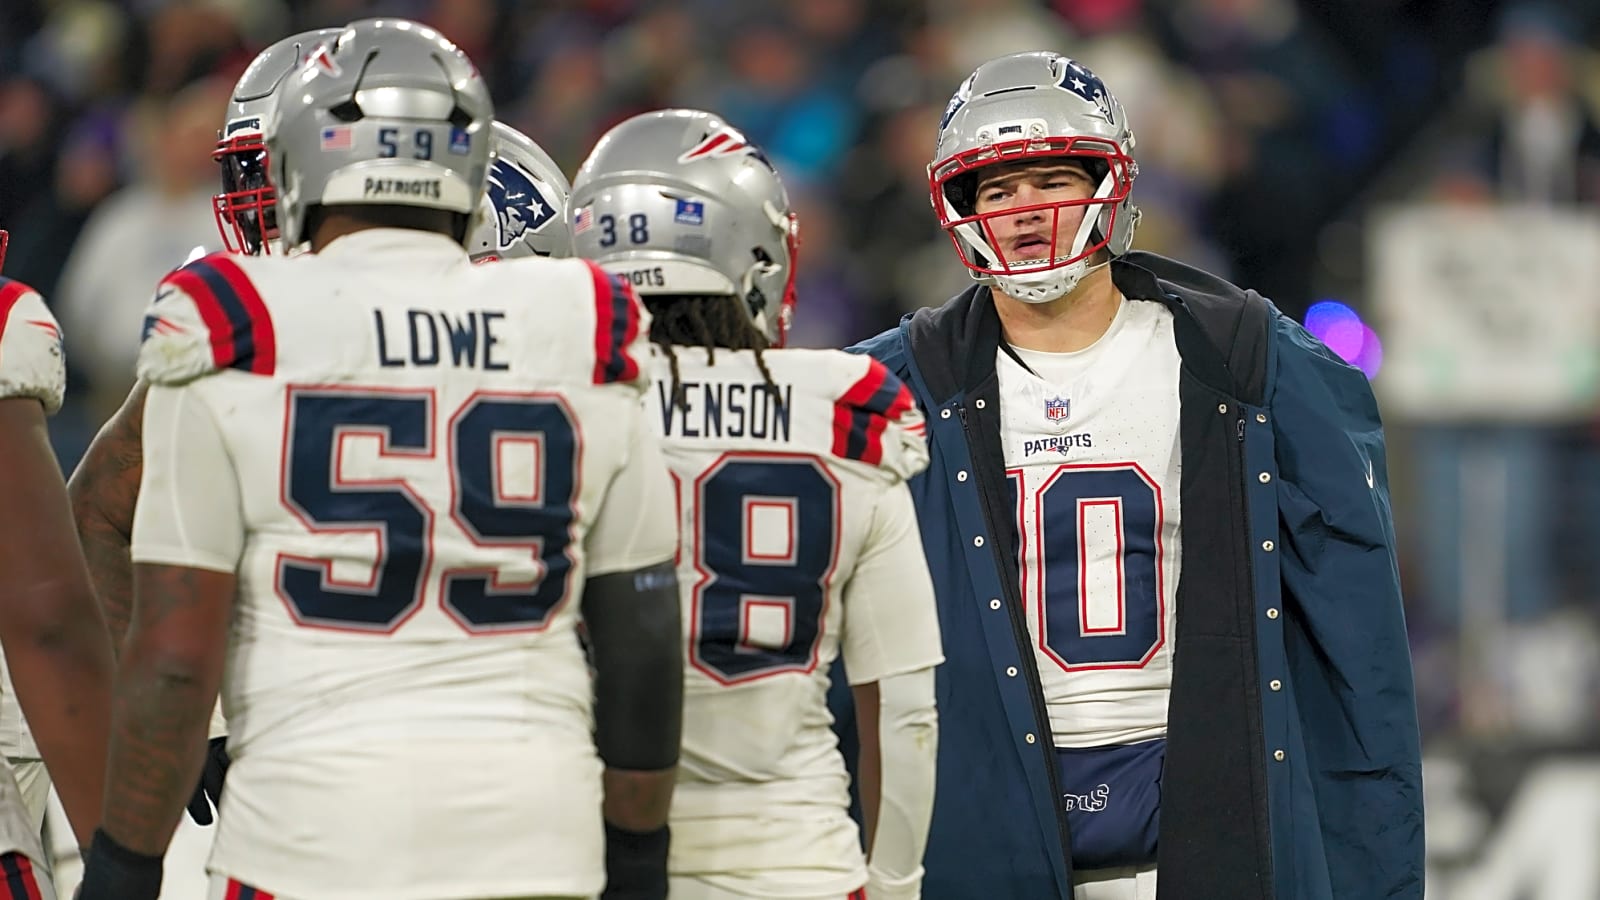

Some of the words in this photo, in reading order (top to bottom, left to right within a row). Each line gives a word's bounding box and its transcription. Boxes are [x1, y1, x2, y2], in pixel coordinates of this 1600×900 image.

[378, 128, 433, 160] 59
[364, 177, 441, 199] PATRIOTS
[599, 213, 649, 247] 38
[374, 308, 509, 371] LOWE
[1048, 407, 1066, 418] NFL
[1024, 433, 1092, 457] PATRIOTS
[274, 384, 584, 637] 59
[668, 450, 842, 687] 8
